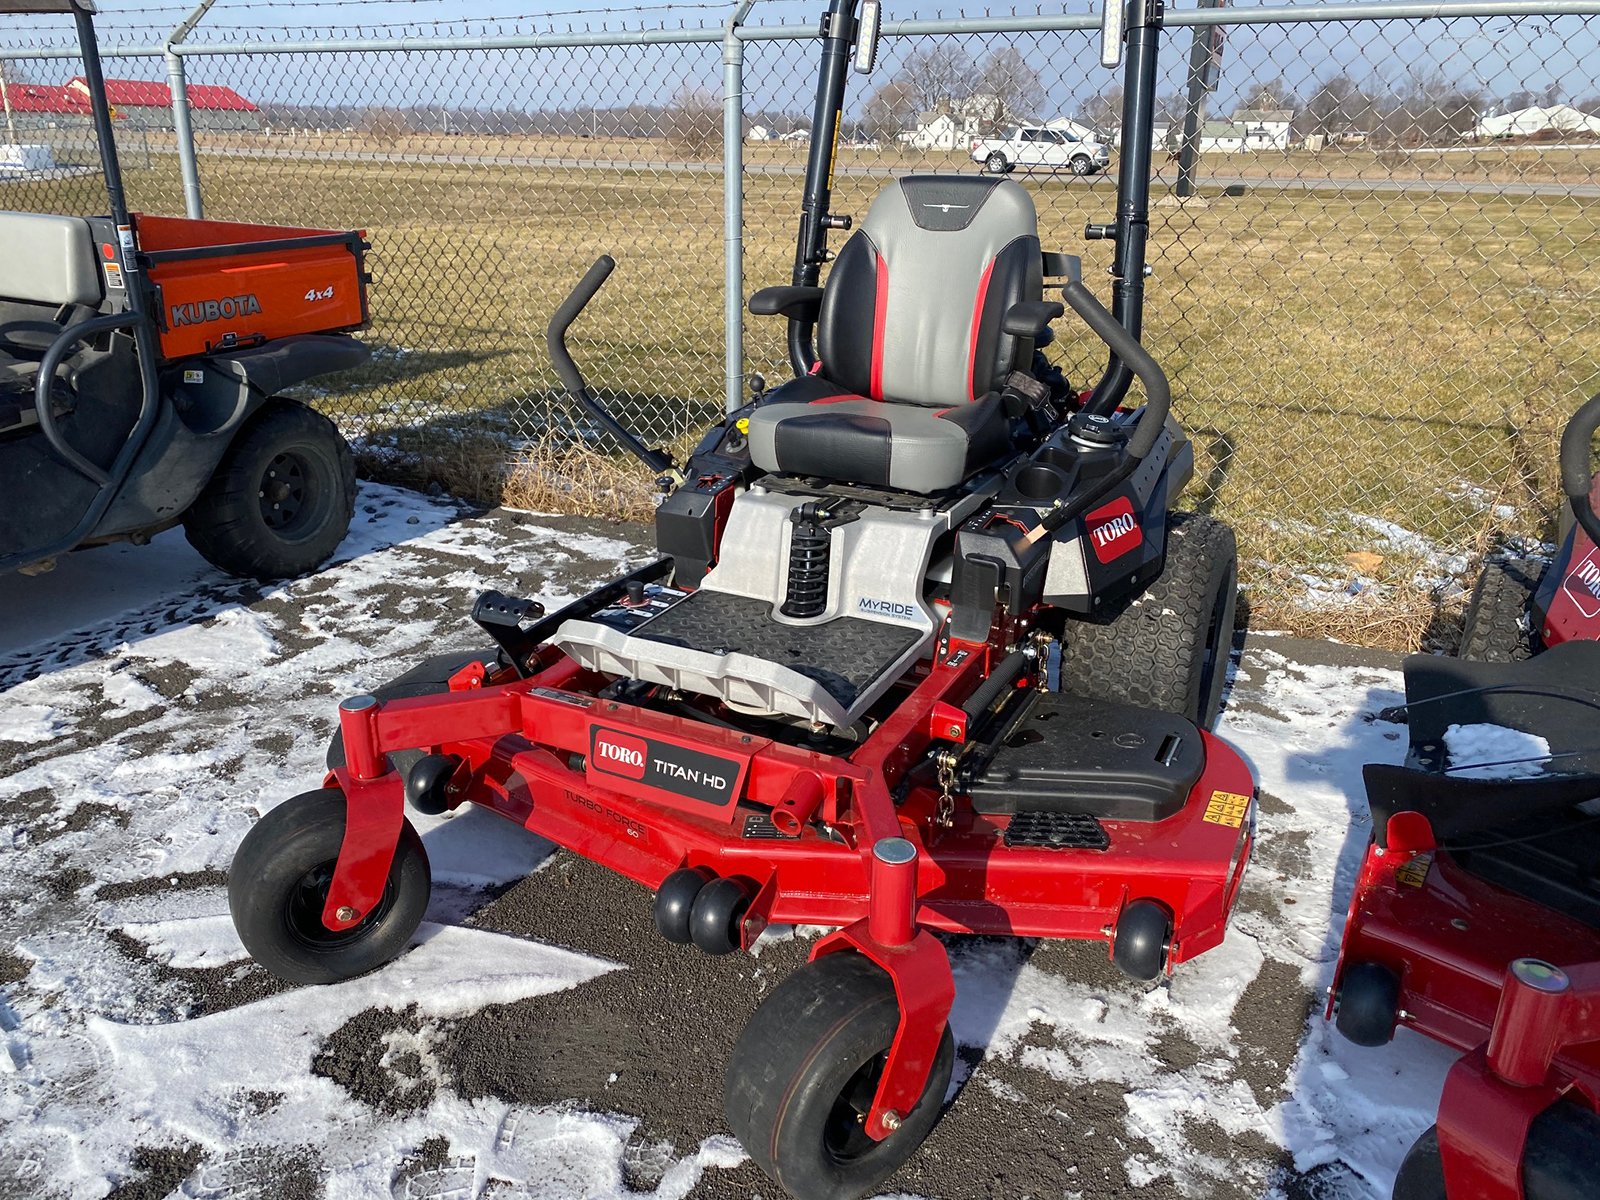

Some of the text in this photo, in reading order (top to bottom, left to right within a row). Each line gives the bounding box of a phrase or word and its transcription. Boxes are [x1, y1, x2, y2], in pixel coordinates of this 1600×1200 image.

[304, 286, 334, 302] 4x4
[171, 294, 262, 327] KUBOTA
[1093, 512, 1137, 547] TORO
[598, 741, 644, 768] TORO
[653, 759, 727, 790] TITAN HD
[564, 789, 646, 834] TURBO FORCE
[627, 828, 639, 838] 60
